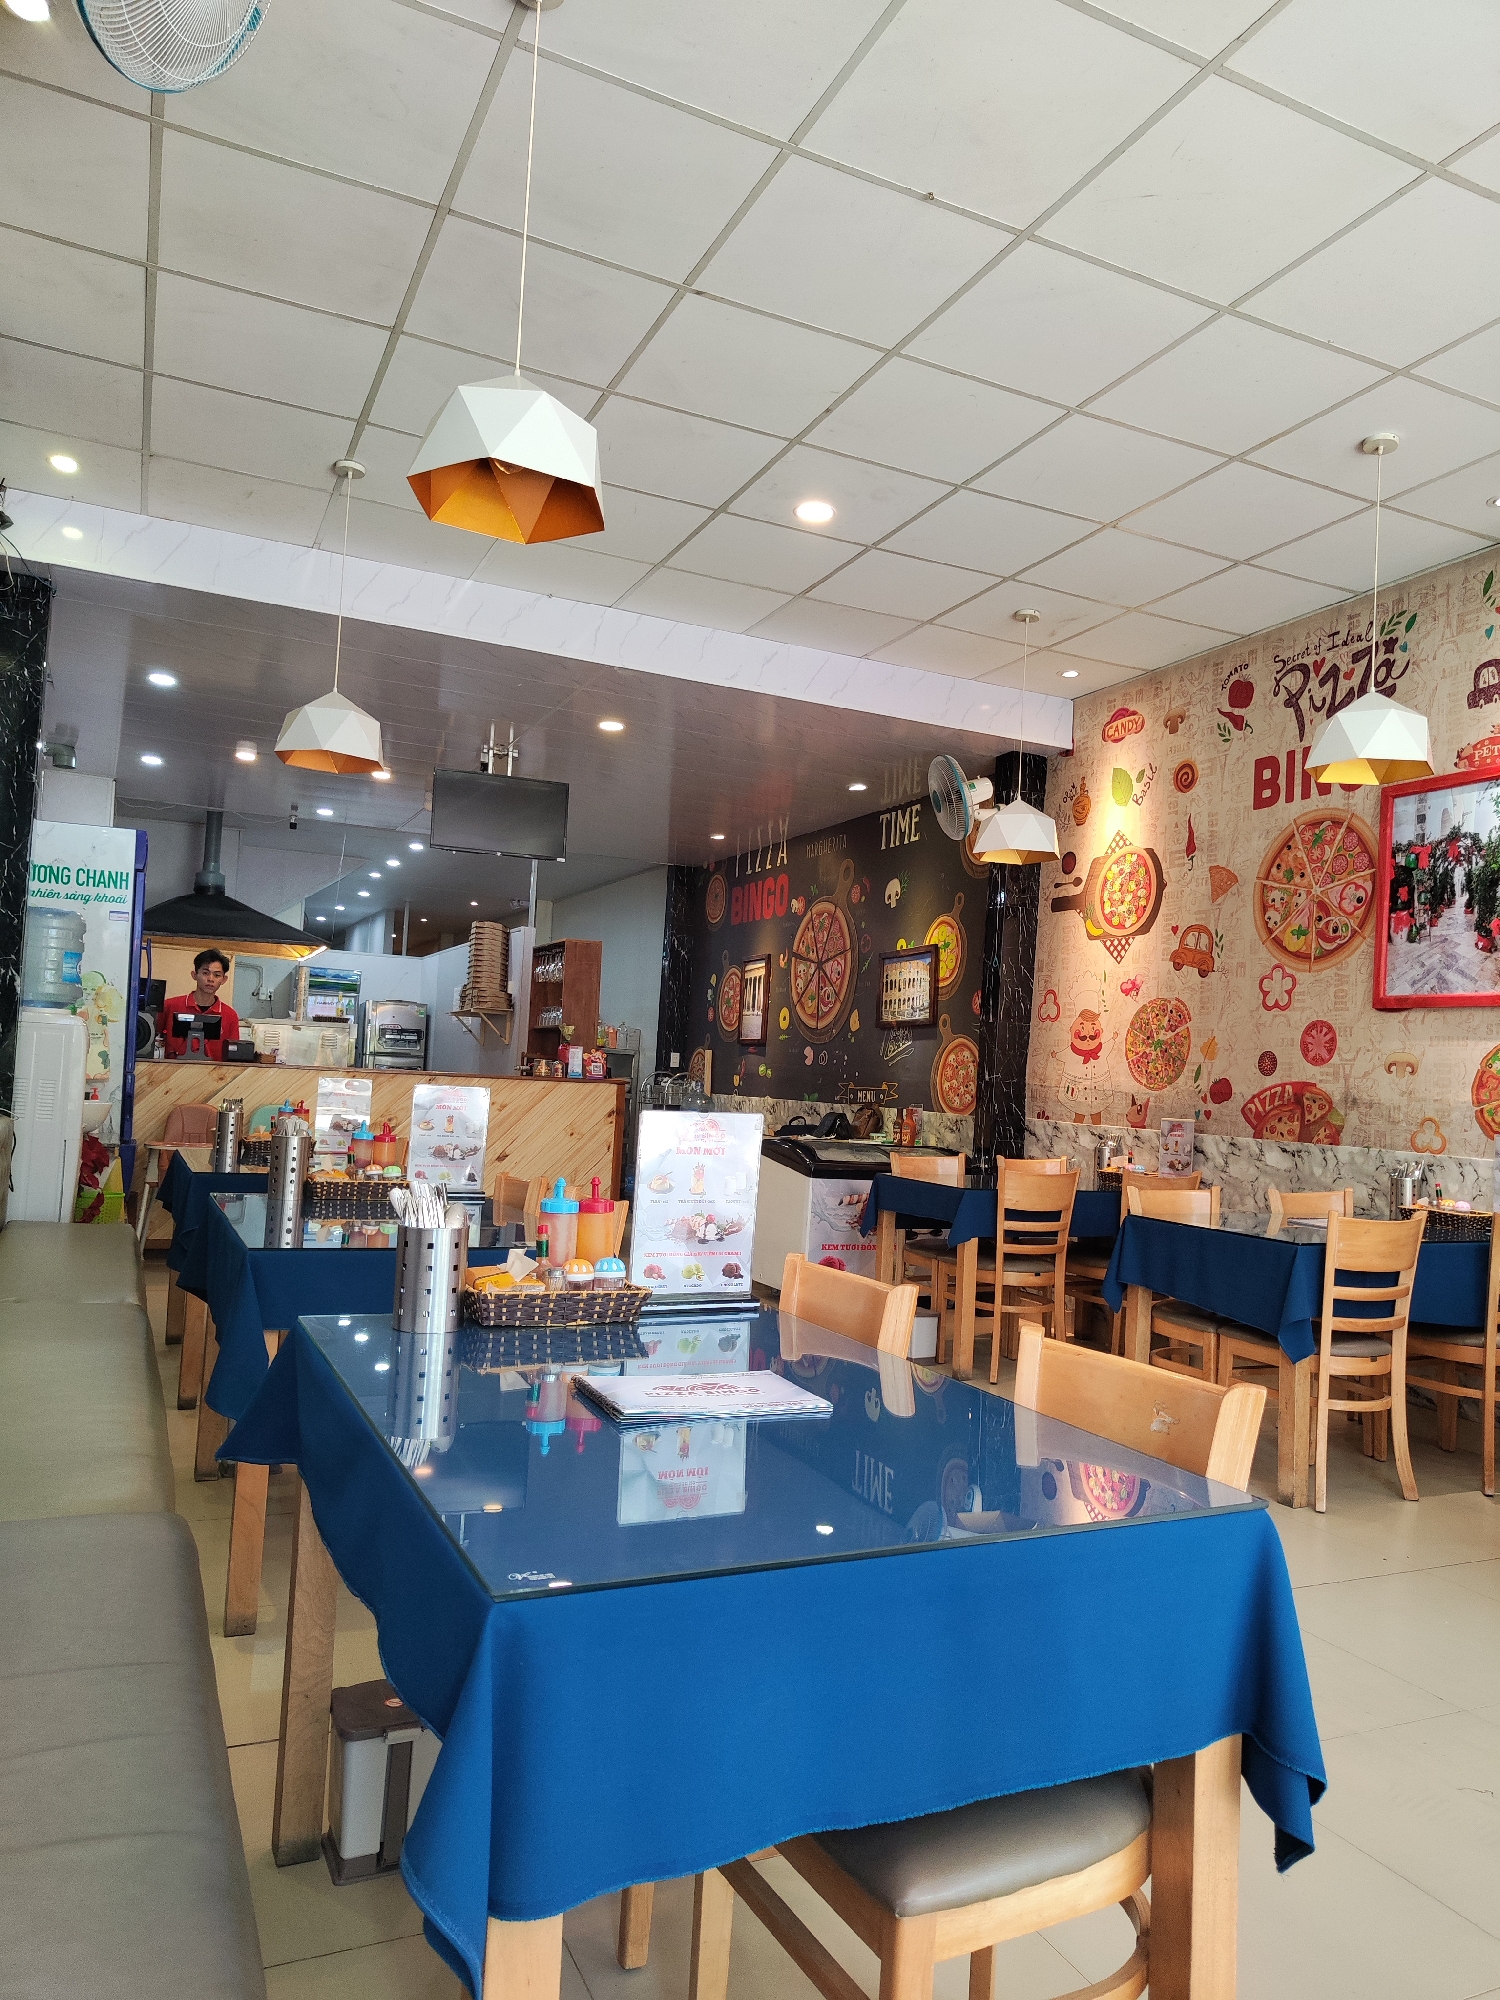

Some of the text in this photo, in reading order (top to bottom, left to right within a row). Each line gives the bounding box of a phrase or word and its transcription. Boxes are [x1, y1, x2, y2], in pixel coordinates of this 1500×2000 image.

[1273, 621, 1374, 674] Secret of Ideal
[1220, 662, 1249, 692] TOMATO
[1106, 716, 1141, 739] CANDY
[878, 803, 922, 850] TIME
[805, 833, 848, 859] MARGHERITA
[75, 867, 130, 890] CHANH
[731, 873, 789, 926] BINGO
[857, 1090, 876, 1103] MENU
[1246, 1084, 1294, 1126] PIZZA
[821, 1243, 839, 1251] KEM
[840, 1243, 860, 1251] TƯƠI
